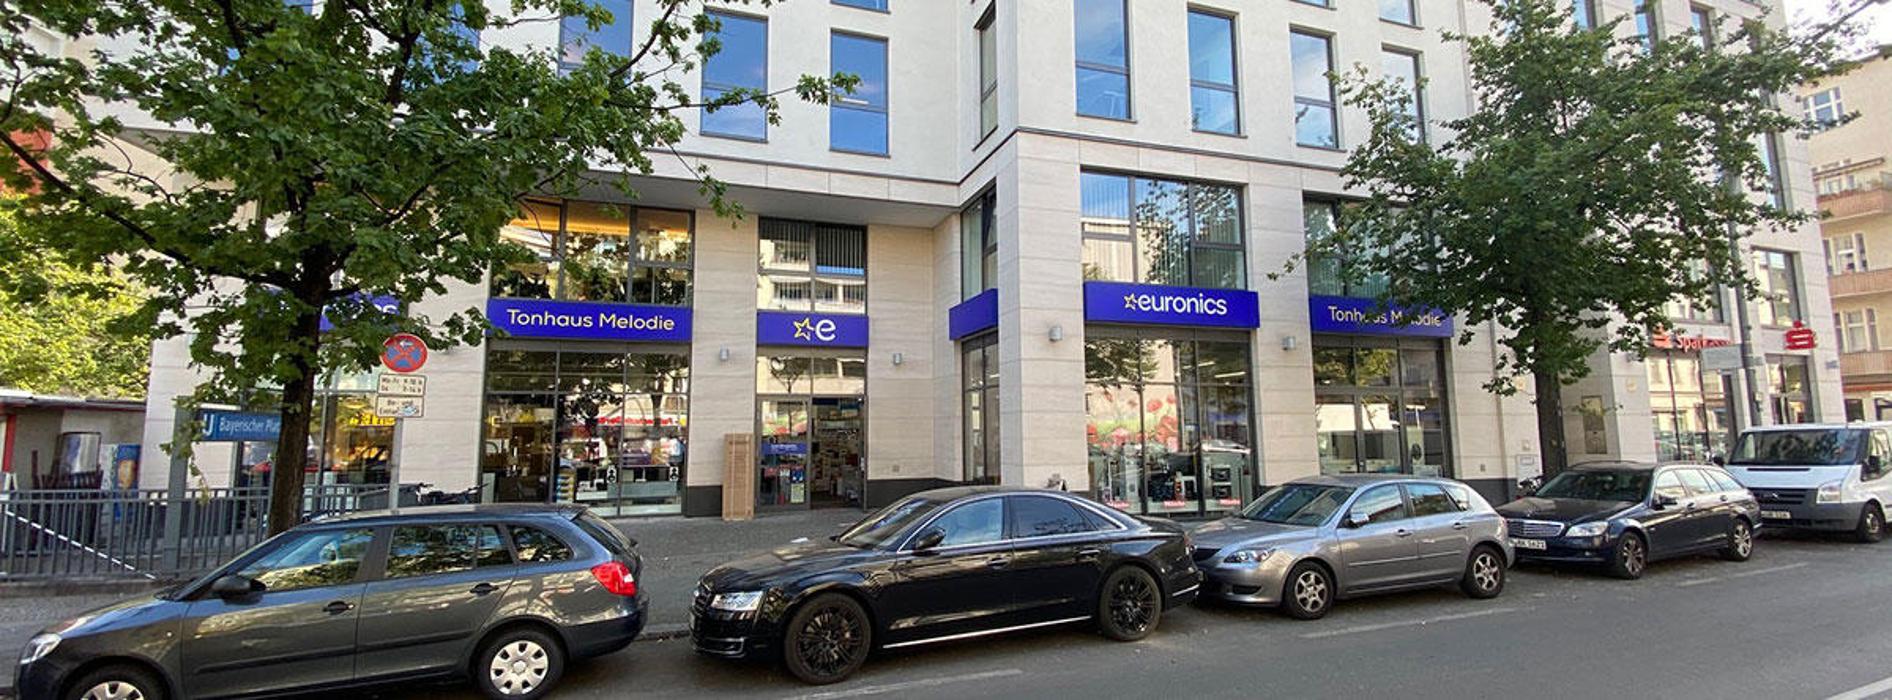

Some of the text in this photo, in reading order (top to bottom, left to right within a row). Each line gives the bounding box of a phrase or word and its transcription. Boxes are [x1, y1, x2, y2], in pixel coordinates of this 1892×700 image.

[1137, 292, 1229, 315] euronics
[506, 308, 675, 331] Tonhaus Melodie
[219, 417, 264, 435] Bayerischer
